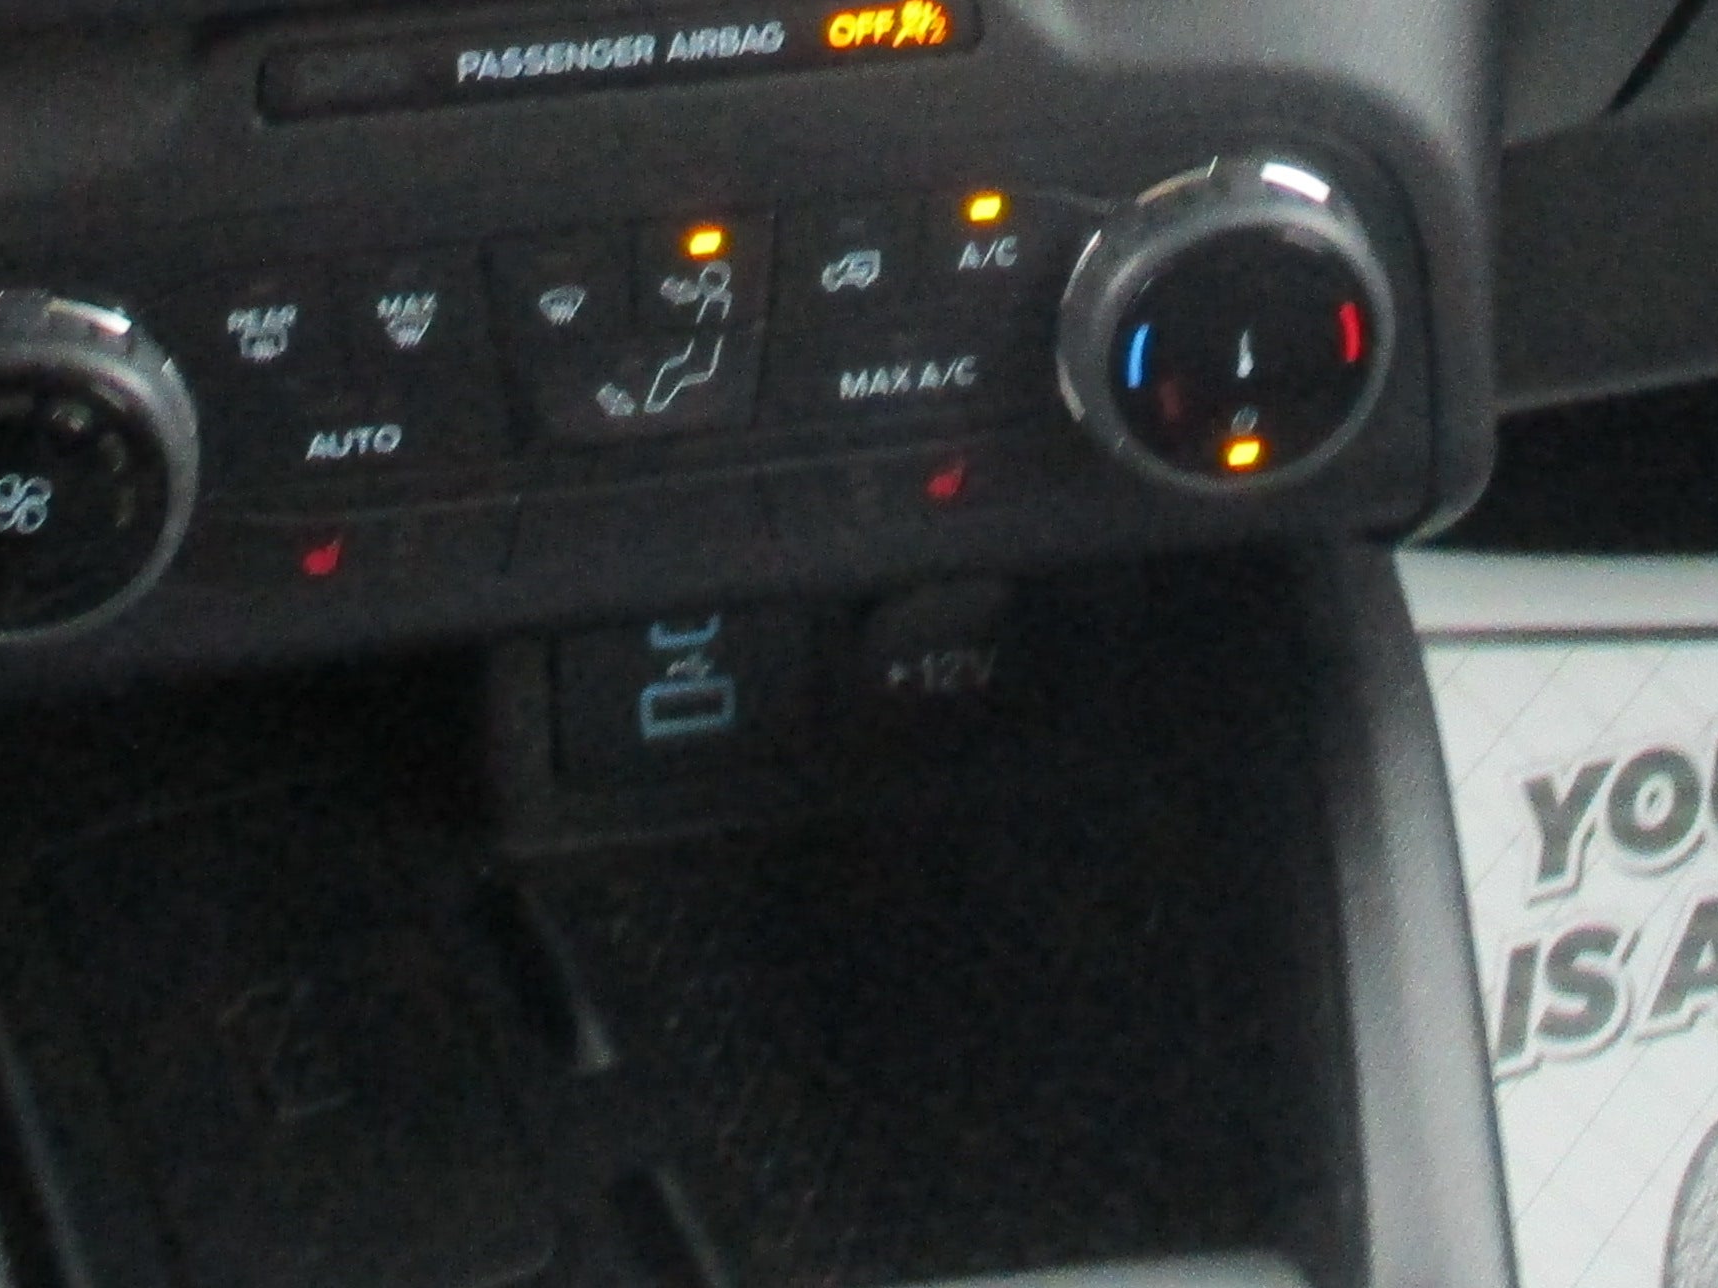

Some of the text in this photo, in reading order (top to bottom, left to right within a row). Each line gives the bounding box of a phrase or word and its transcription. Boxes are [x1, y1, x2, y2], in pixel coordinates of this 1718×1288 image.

[456, 8, 896, 84] PASSENGER AIRBAG OFF
[957, 235, 1019, 272] A/C
[838, 355, 979, 401] MAX A/C
[304, 423, 404, 463] AUTO
[1495, 924, 1641, 1074] IS
